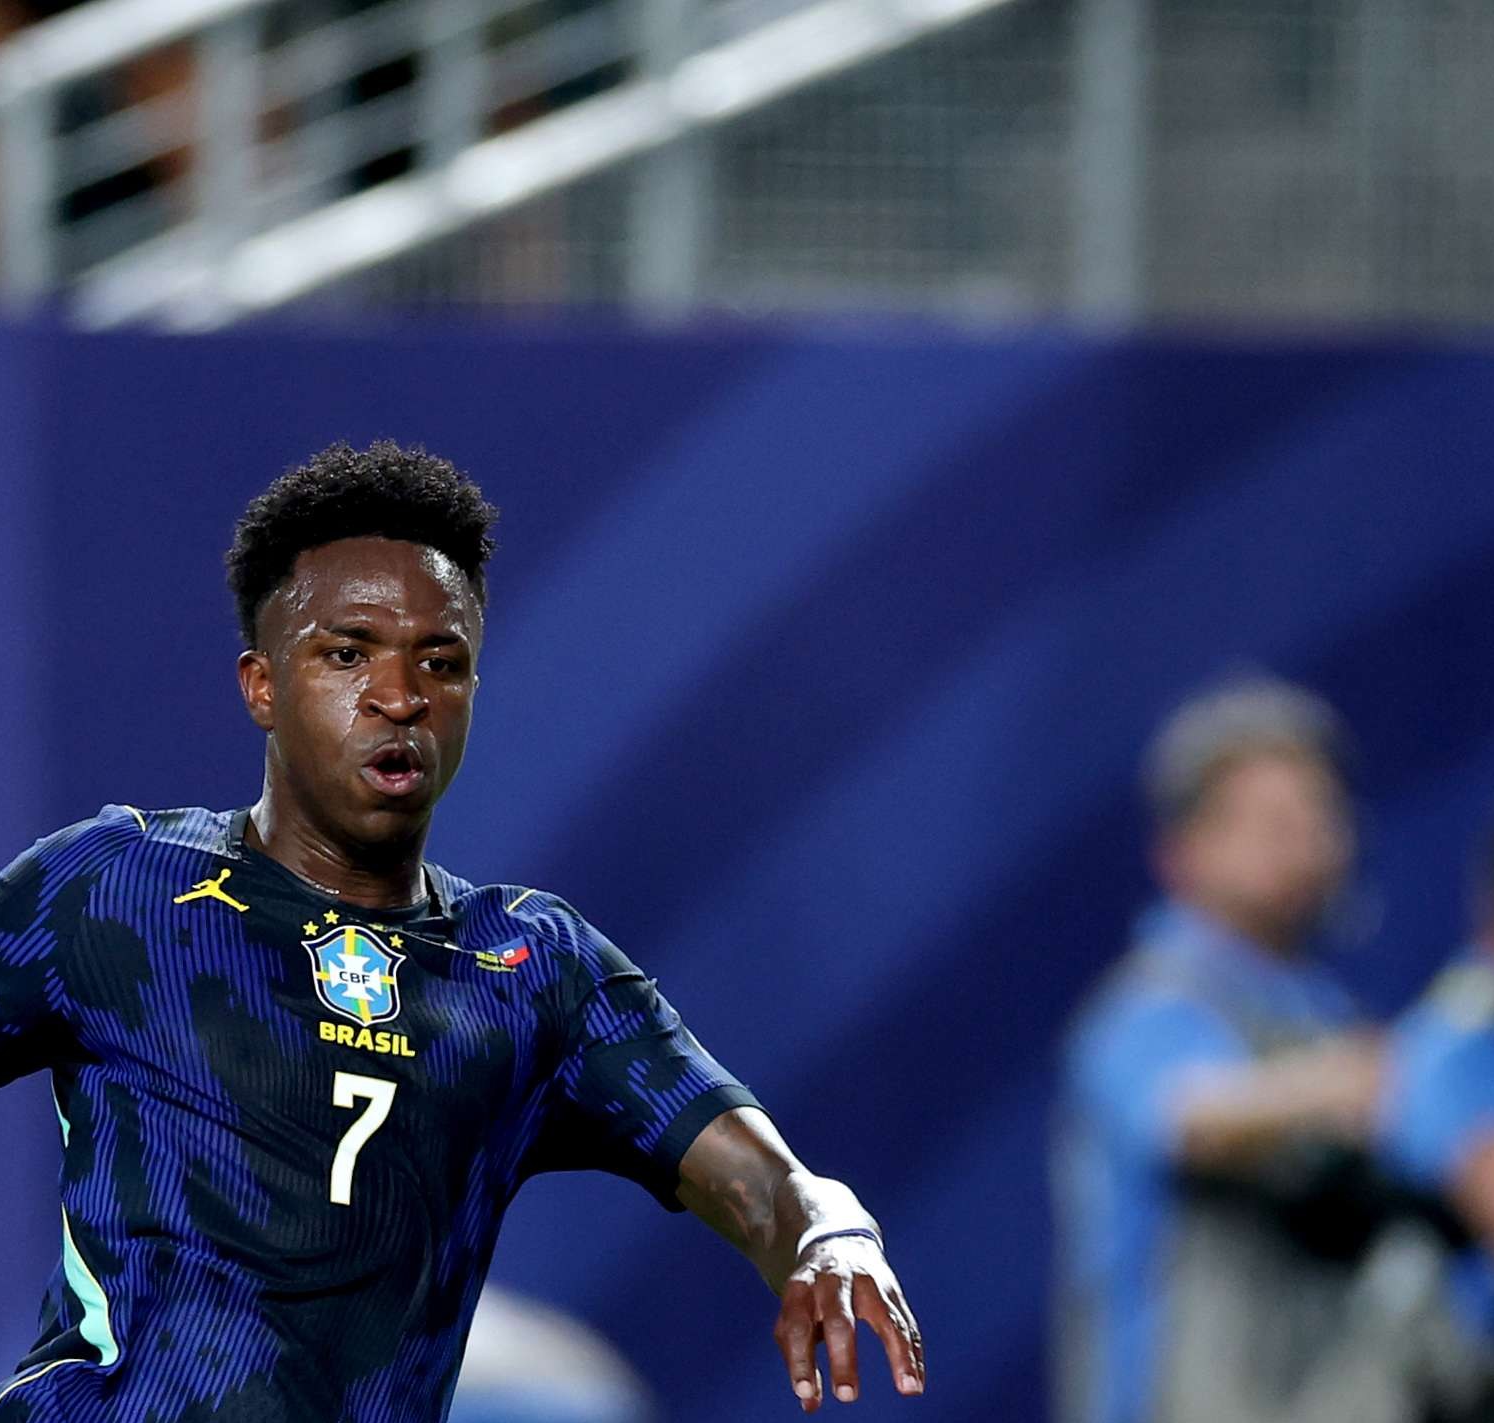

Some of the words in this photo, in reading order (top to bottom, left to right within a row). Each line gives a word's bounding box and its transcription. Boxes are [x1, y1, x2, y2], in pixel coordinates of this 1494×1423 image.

[338, 970, 371, 985] CBF
[319, 1021, 416, 1057] BRASIL
[329, 1070, 398, 1206] 7
